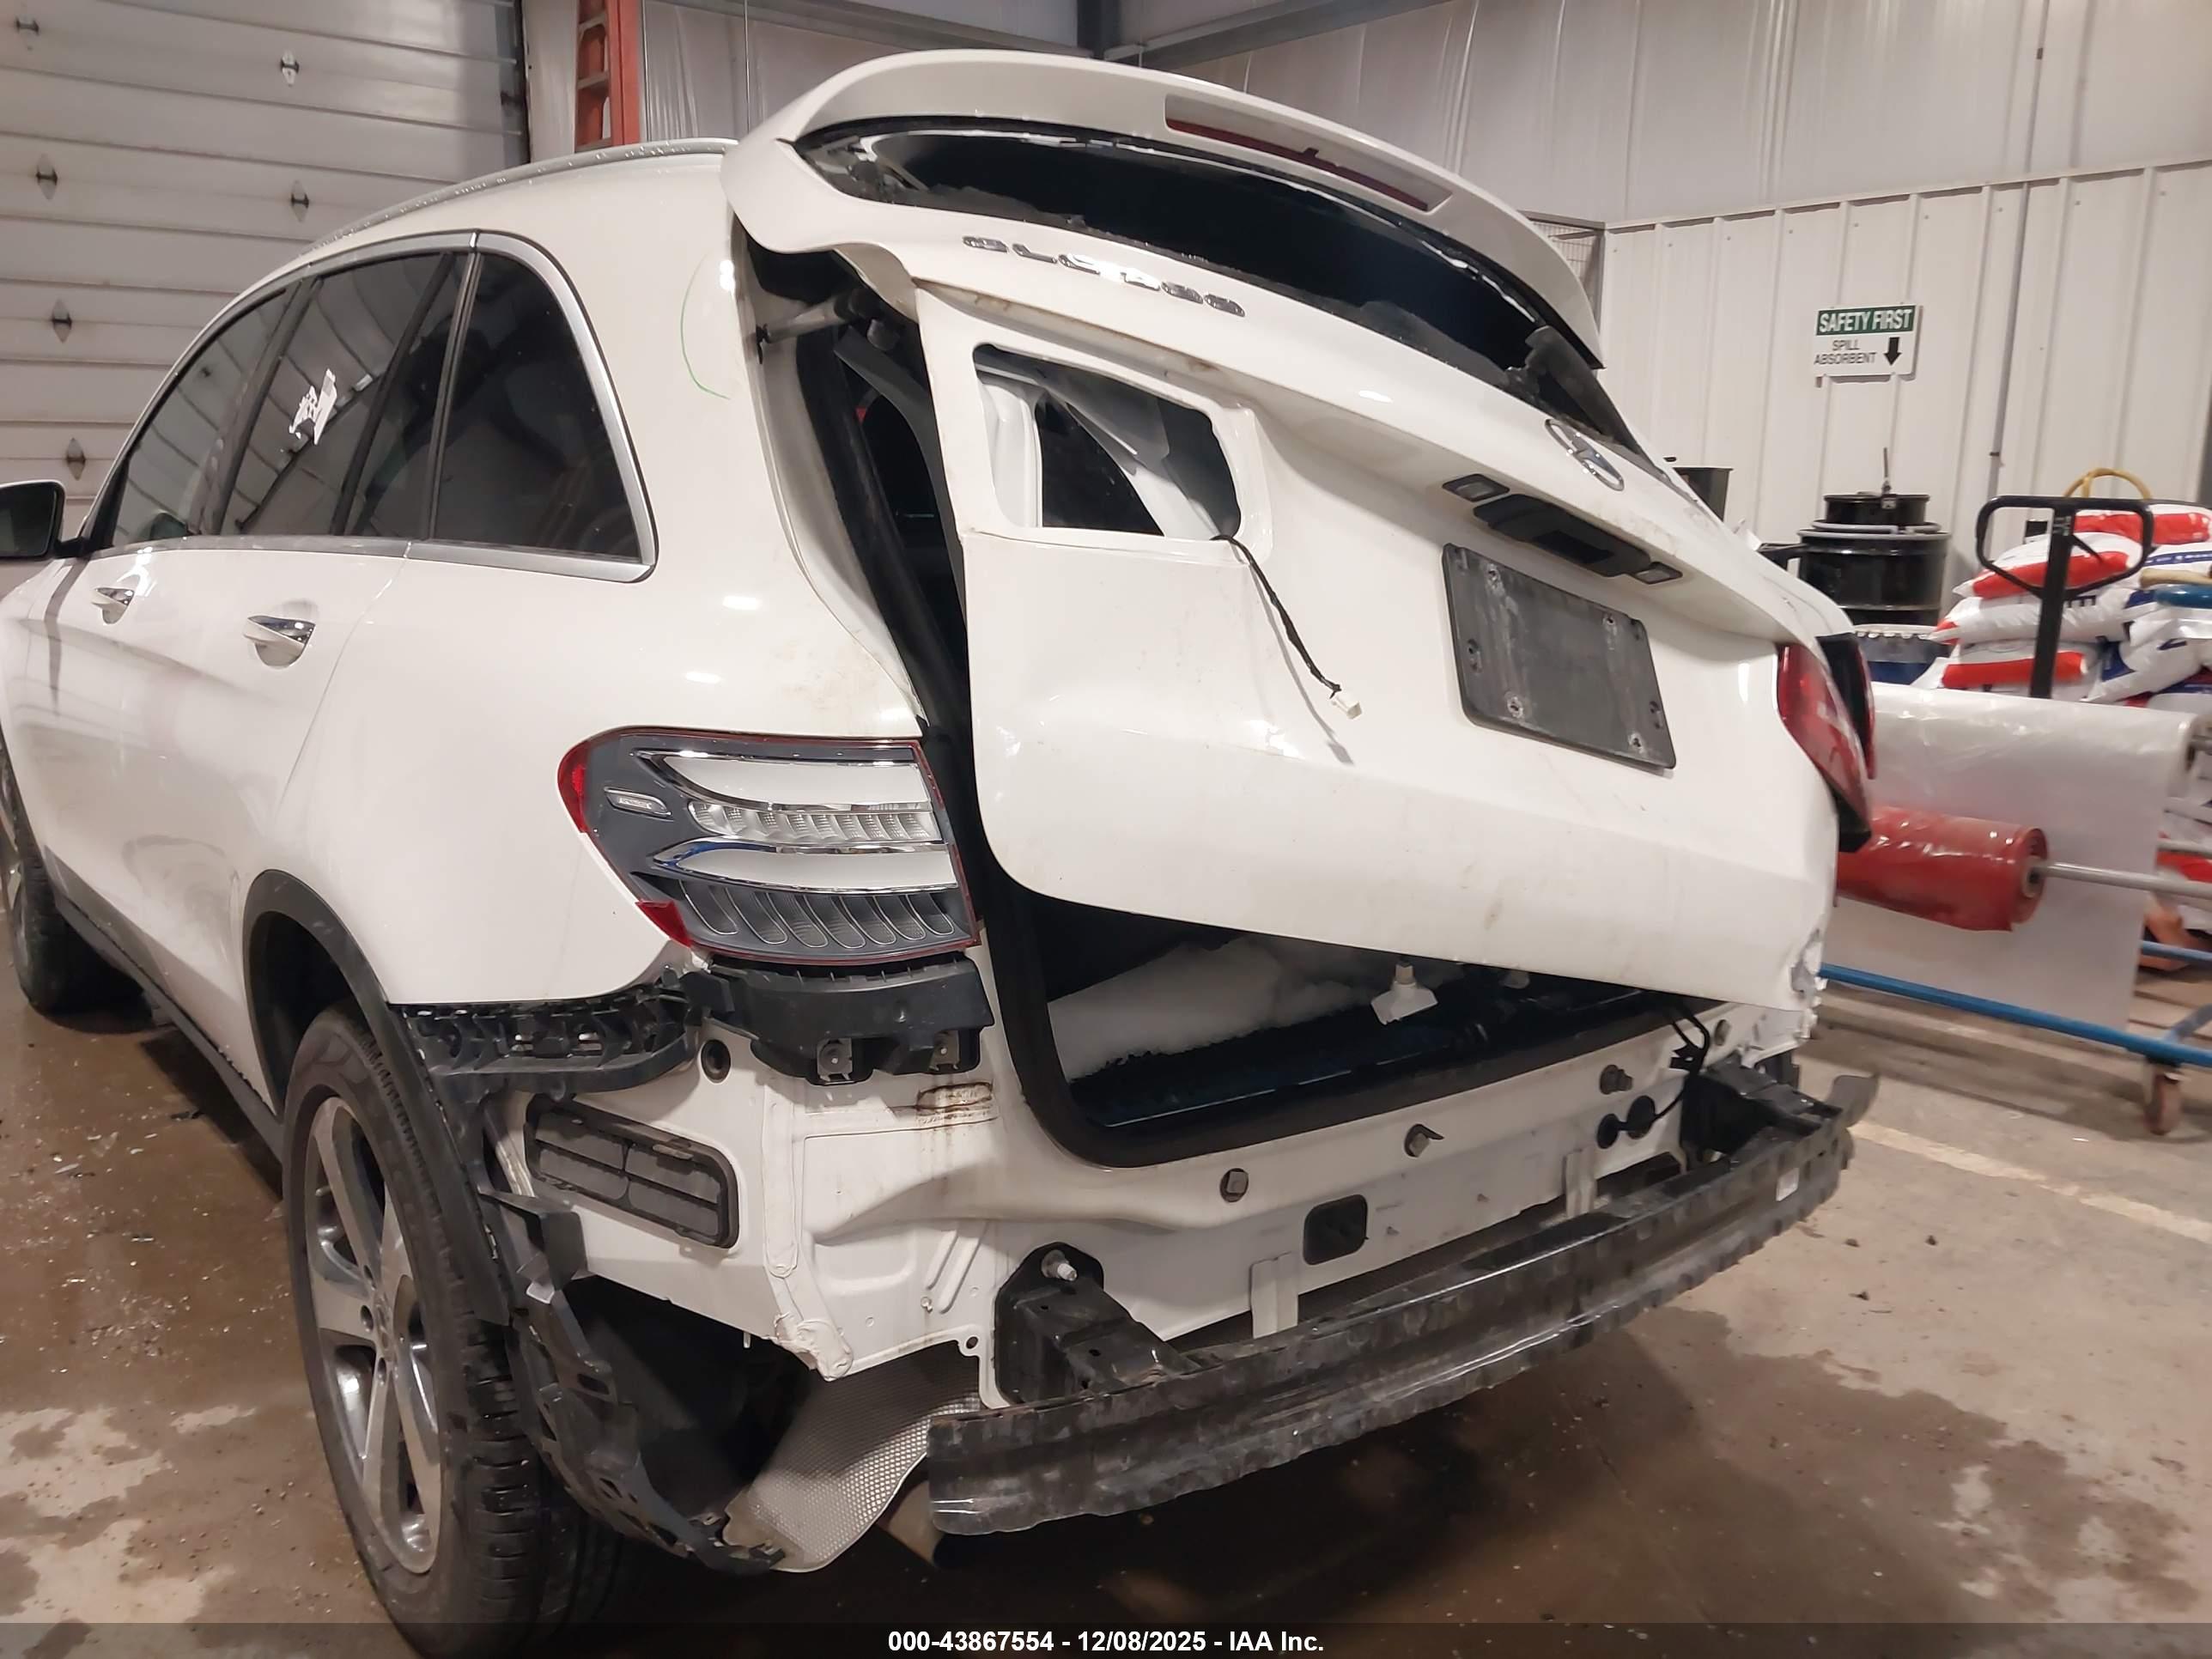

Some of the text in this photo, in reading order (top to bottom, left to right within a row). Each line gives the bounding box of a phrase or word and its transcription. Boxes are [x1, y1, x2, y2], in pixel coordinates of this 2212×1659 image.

[1819, 309, 1913, 332] SAFETY FIRST
[1832, 339, 1860, 351] SPILL
[1814, 352, 1877, 365] ABSORBENT
